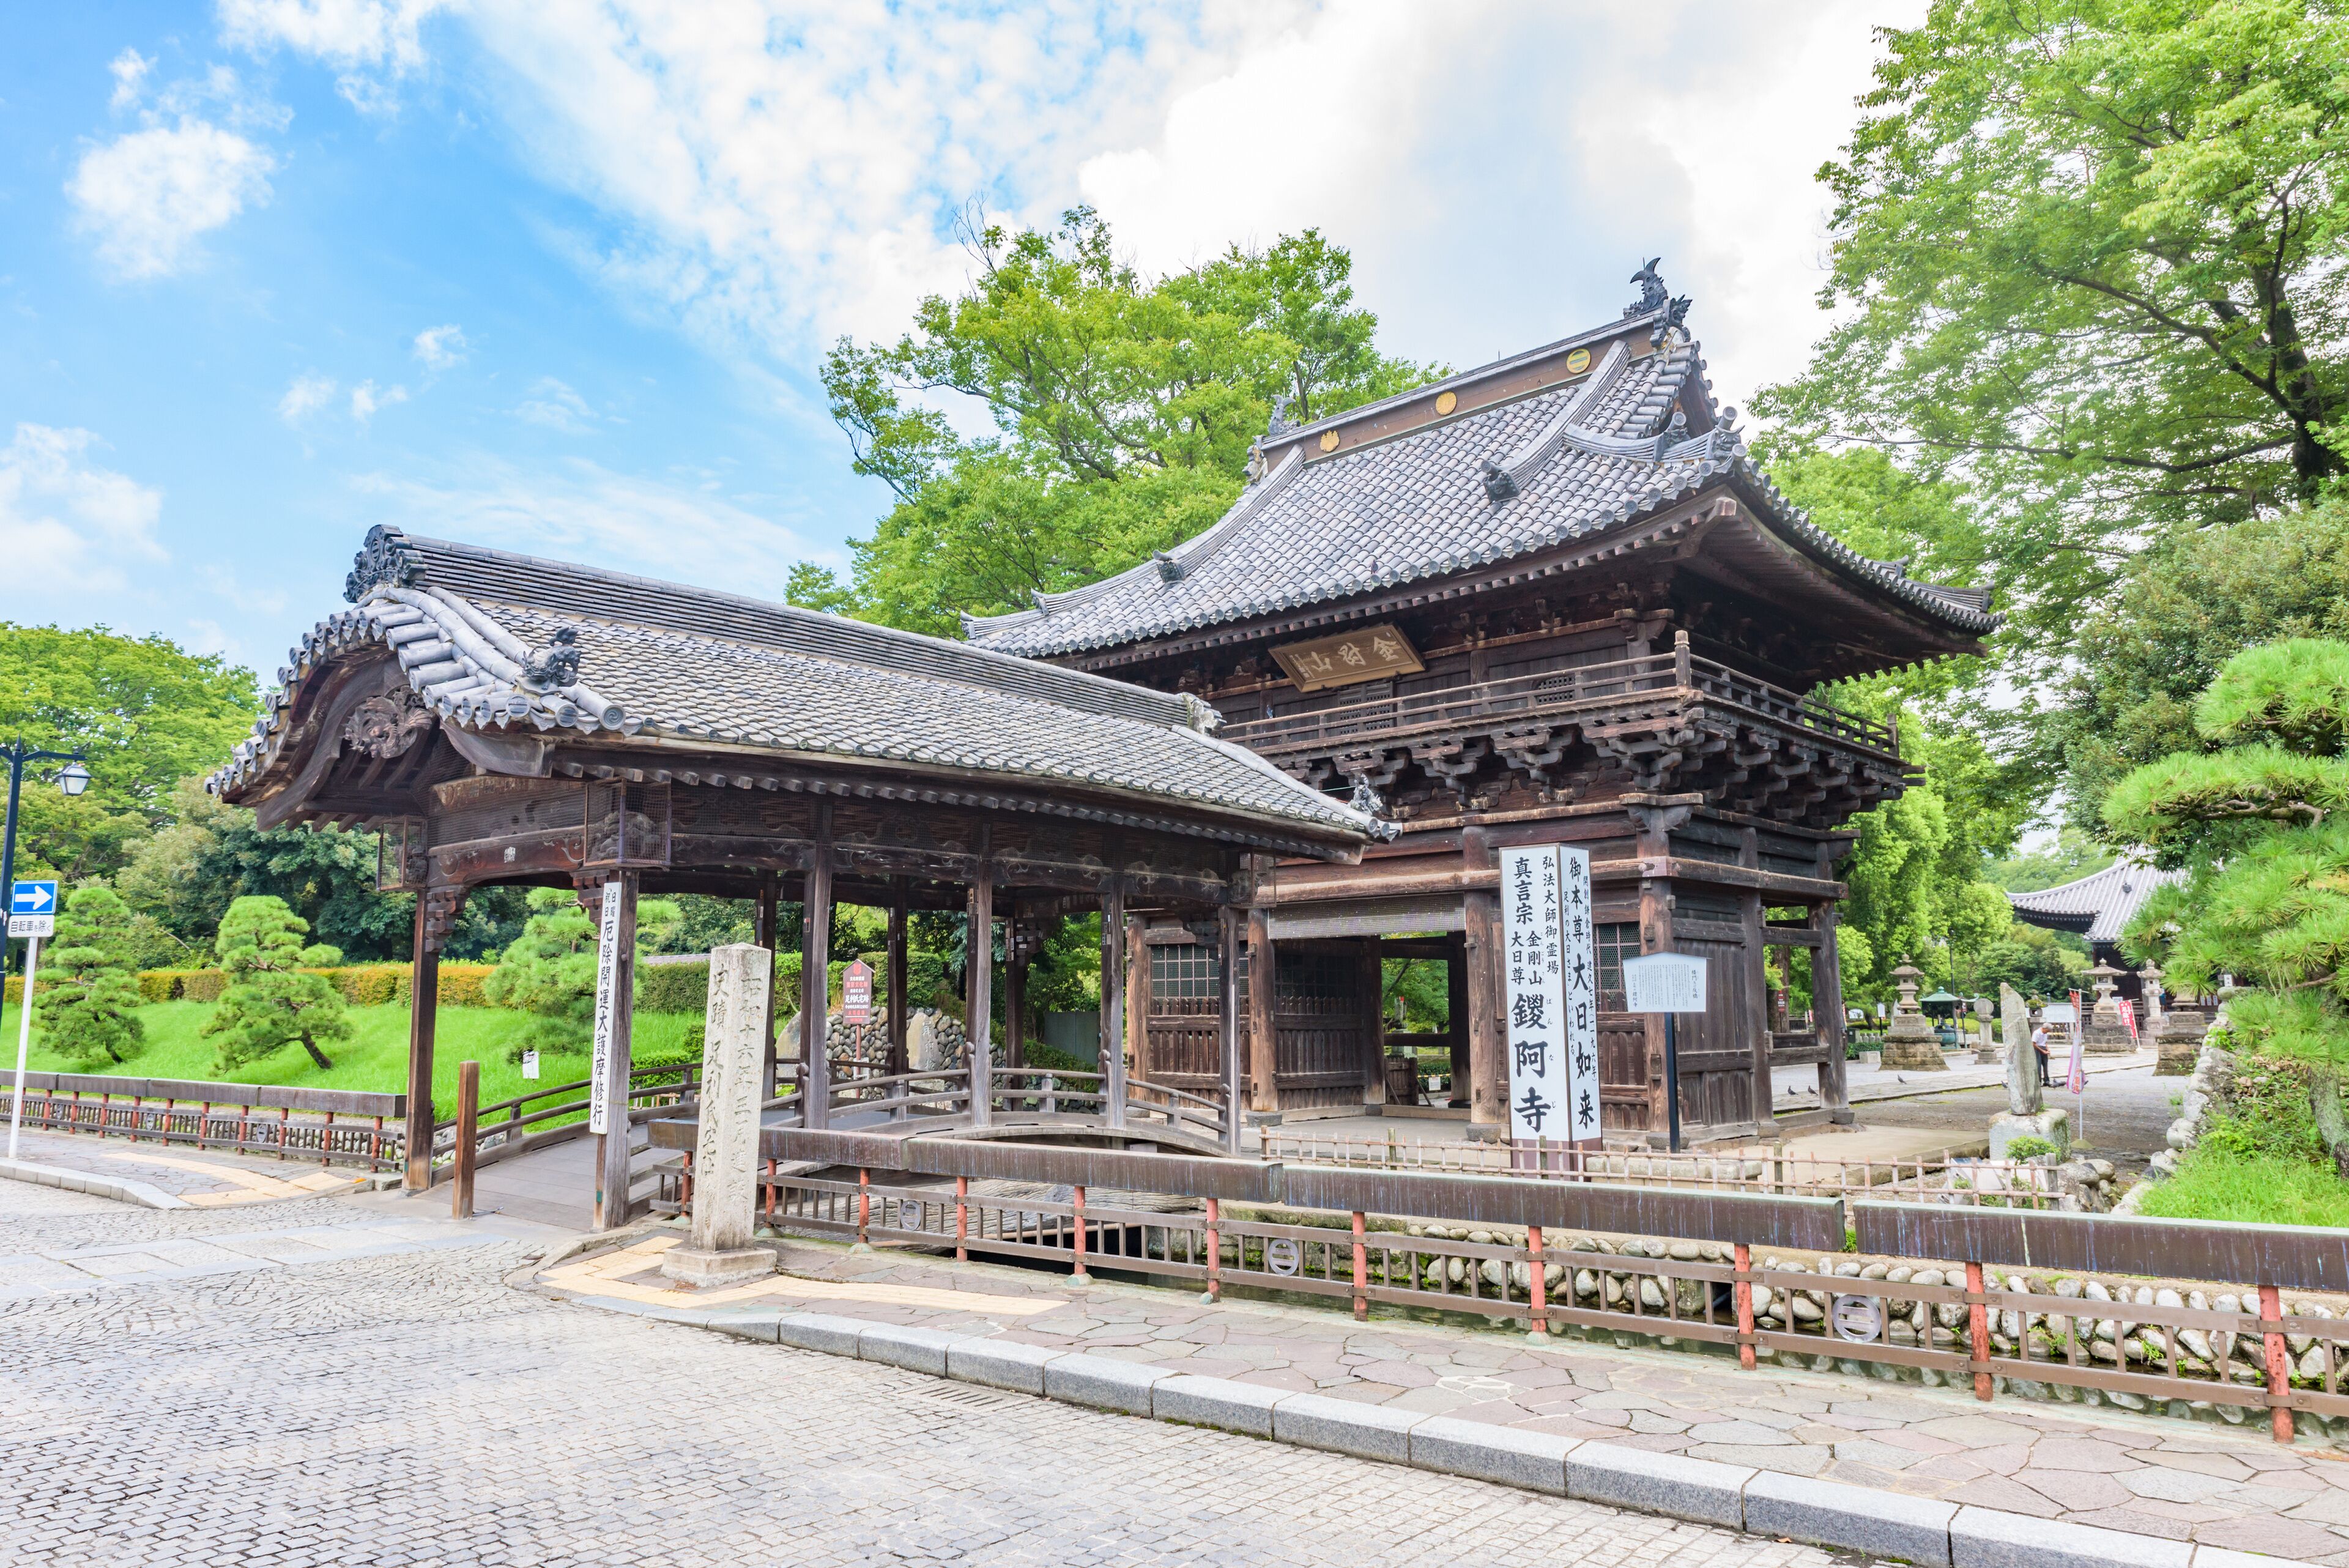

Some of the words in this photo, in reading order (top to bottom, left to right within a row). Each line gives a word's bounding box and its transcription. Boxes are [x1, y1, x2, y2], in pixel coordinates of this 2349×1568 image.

[11, 920, 51, 932] 自転車を除く
[1513, 856, 1533, 926] 真言宗
[1542, 856, 1560, 975] 弘法大師御霊場
[1510, 931, 1526, 986] 大日尊
[1526, 930, 1543, 986] 金剛山
[592, 920, 614, 1126] 厄除開運大護摩修行
[1510, 992, 1552, 1133] 鑁阿寺
